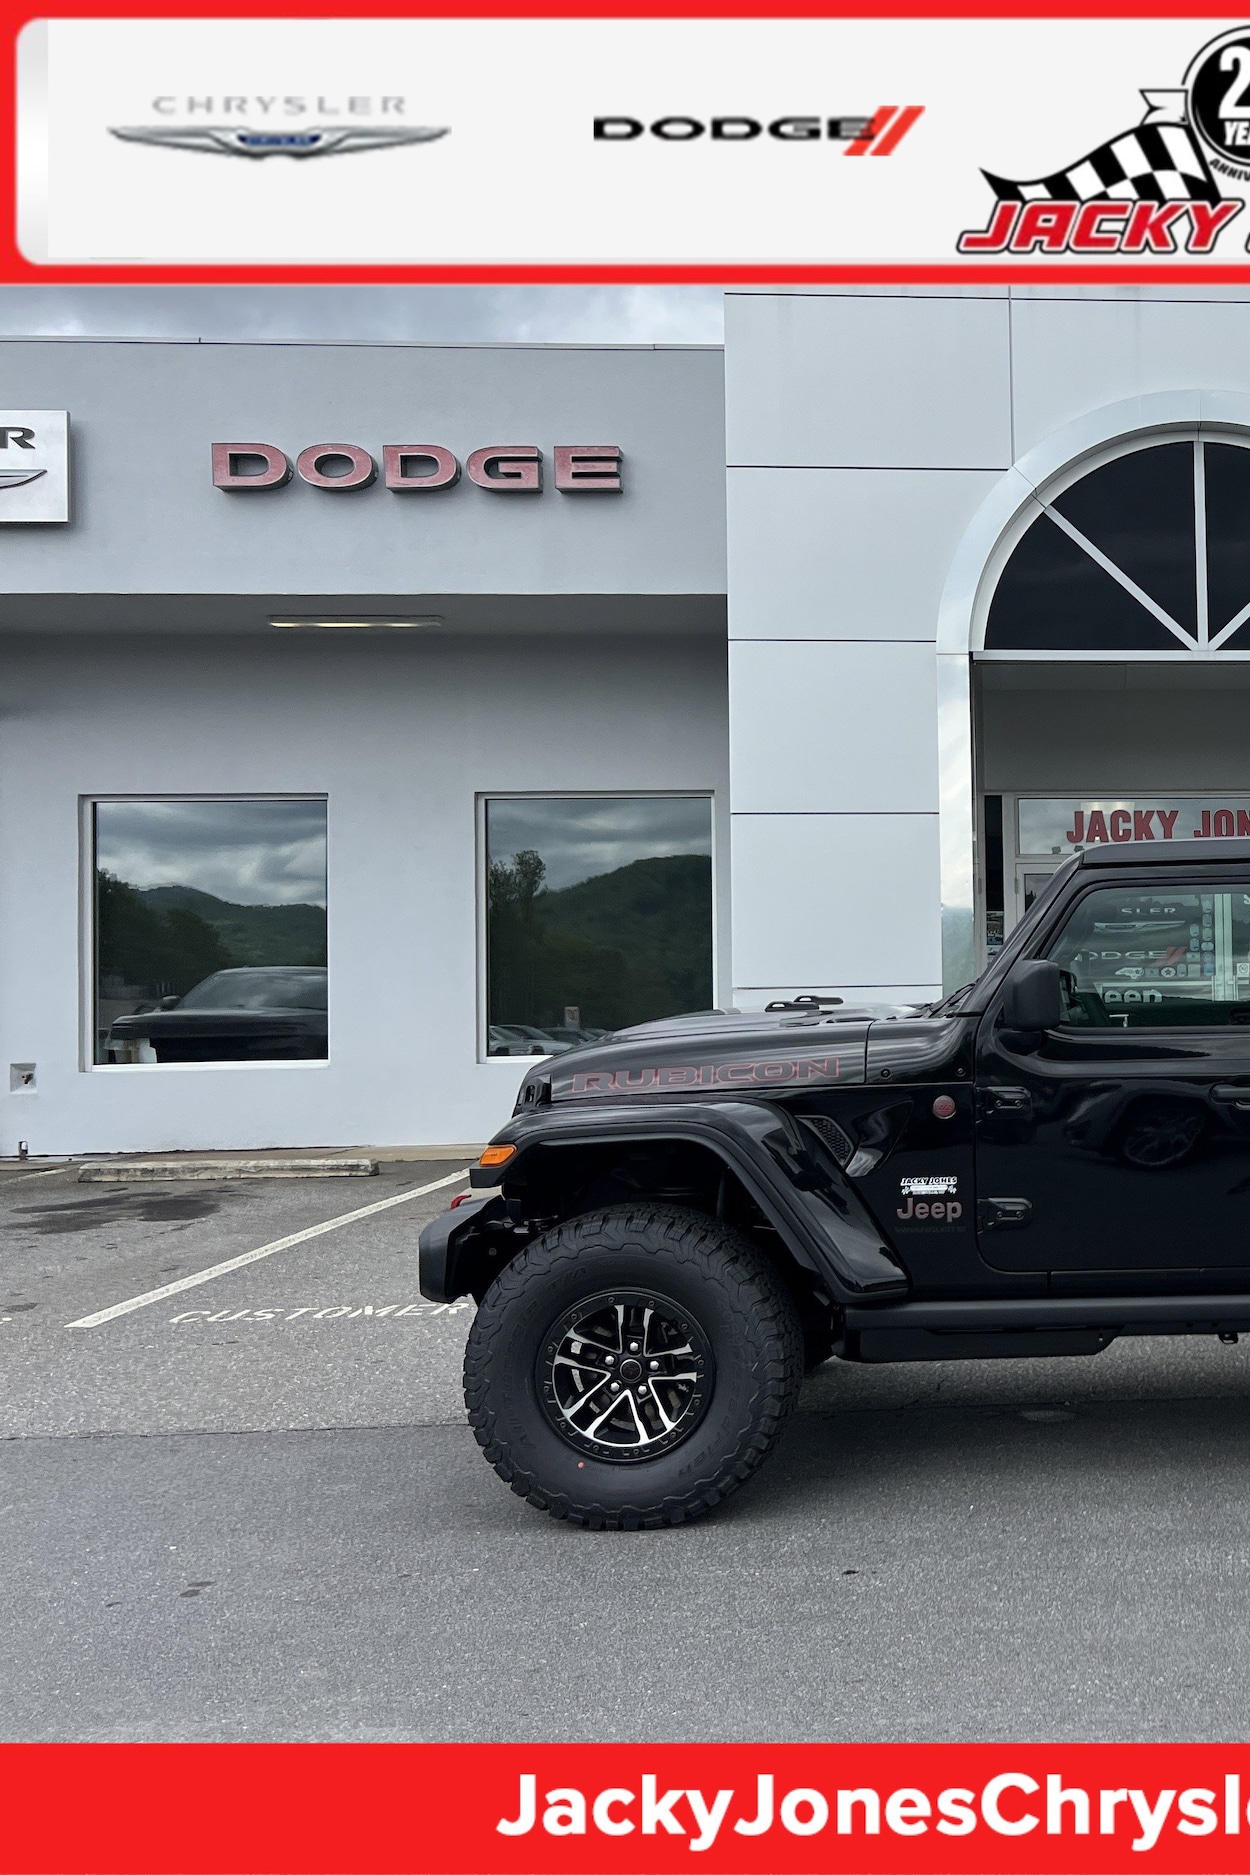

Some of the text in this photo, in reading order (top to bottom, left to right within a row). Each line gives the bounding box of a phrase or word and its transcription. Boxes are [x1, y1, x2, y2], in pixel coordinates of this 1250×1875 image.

[211, 442, 624, 494] DODGE
[1066, 810, 1179, 843] JACKY
[572, 1057, 840, 1093] RUBICON
[900, 1176, 958, 1186] JACKY JONES
[896, 1197, 963, 1223] Jeep
[169, 1303, 470, 1324] CUSTOMER
